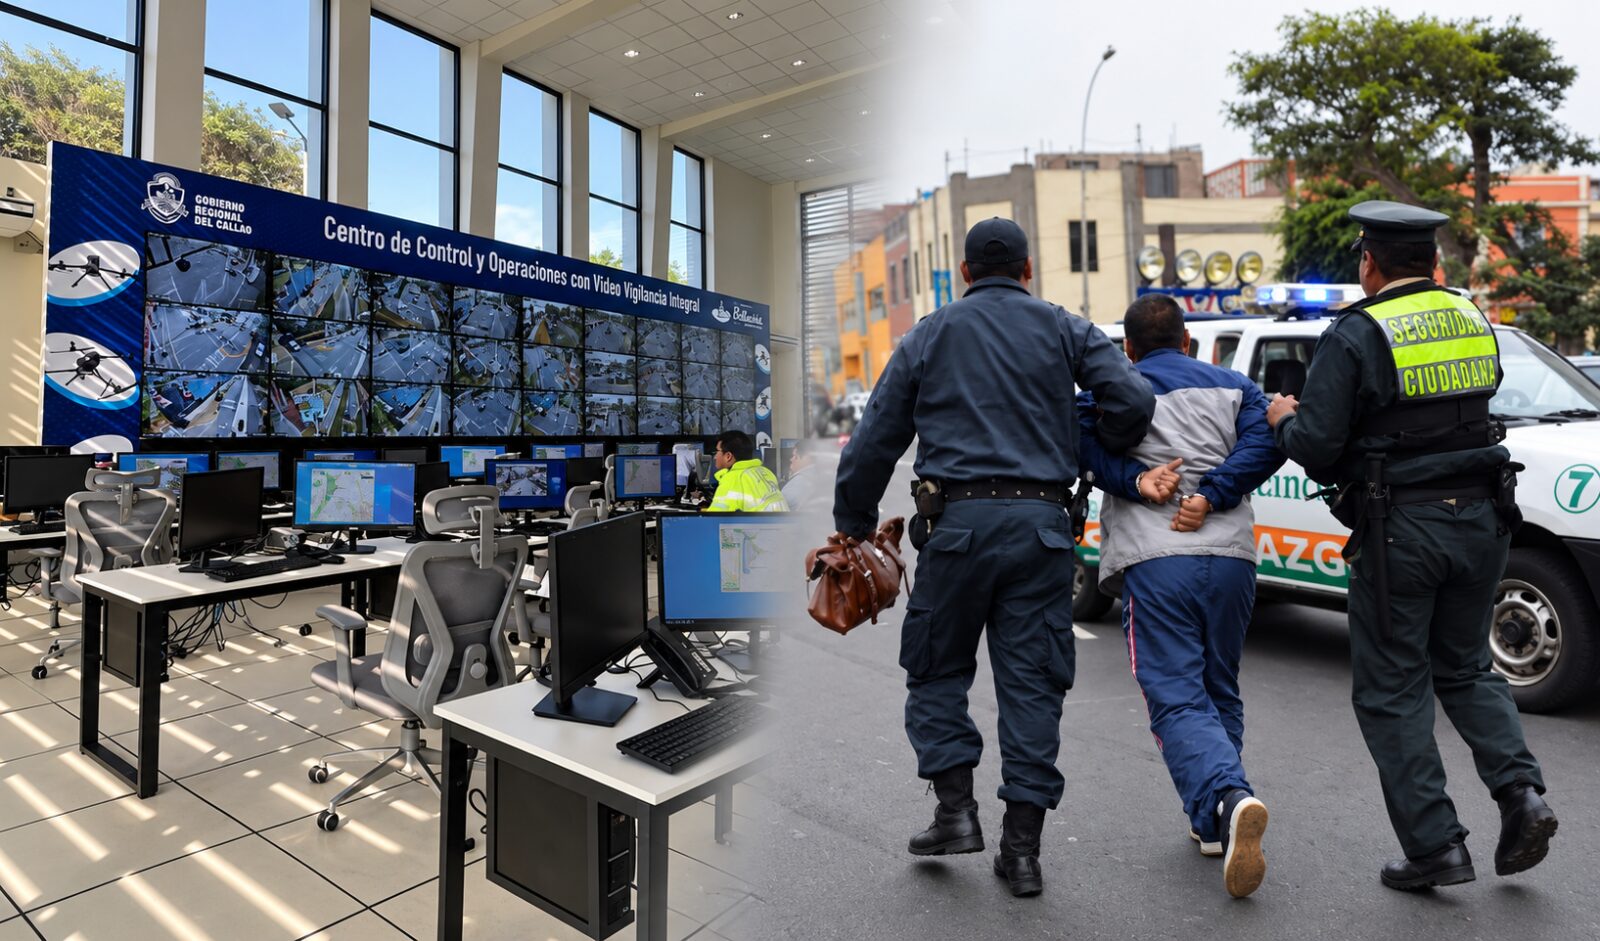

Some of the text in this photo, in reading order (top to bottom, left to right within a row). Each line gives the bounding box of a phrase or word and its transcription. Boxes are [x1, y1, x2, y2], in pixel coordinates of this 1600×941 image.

[194, 205, 243, 222] REGIONAL
[195, 195, 245, 212] GOBIERNO
[194, 216, 252, 234] DEL CALLAO
[324, 216, 700, 314] Centro de Control y Operaciones con Video Vigilancia Integral
[1403, 358, 1496, 397] CIUDADANA
[1569, 470, 1594, 508] 7
[1256, 532, 1351, 577] AZG
